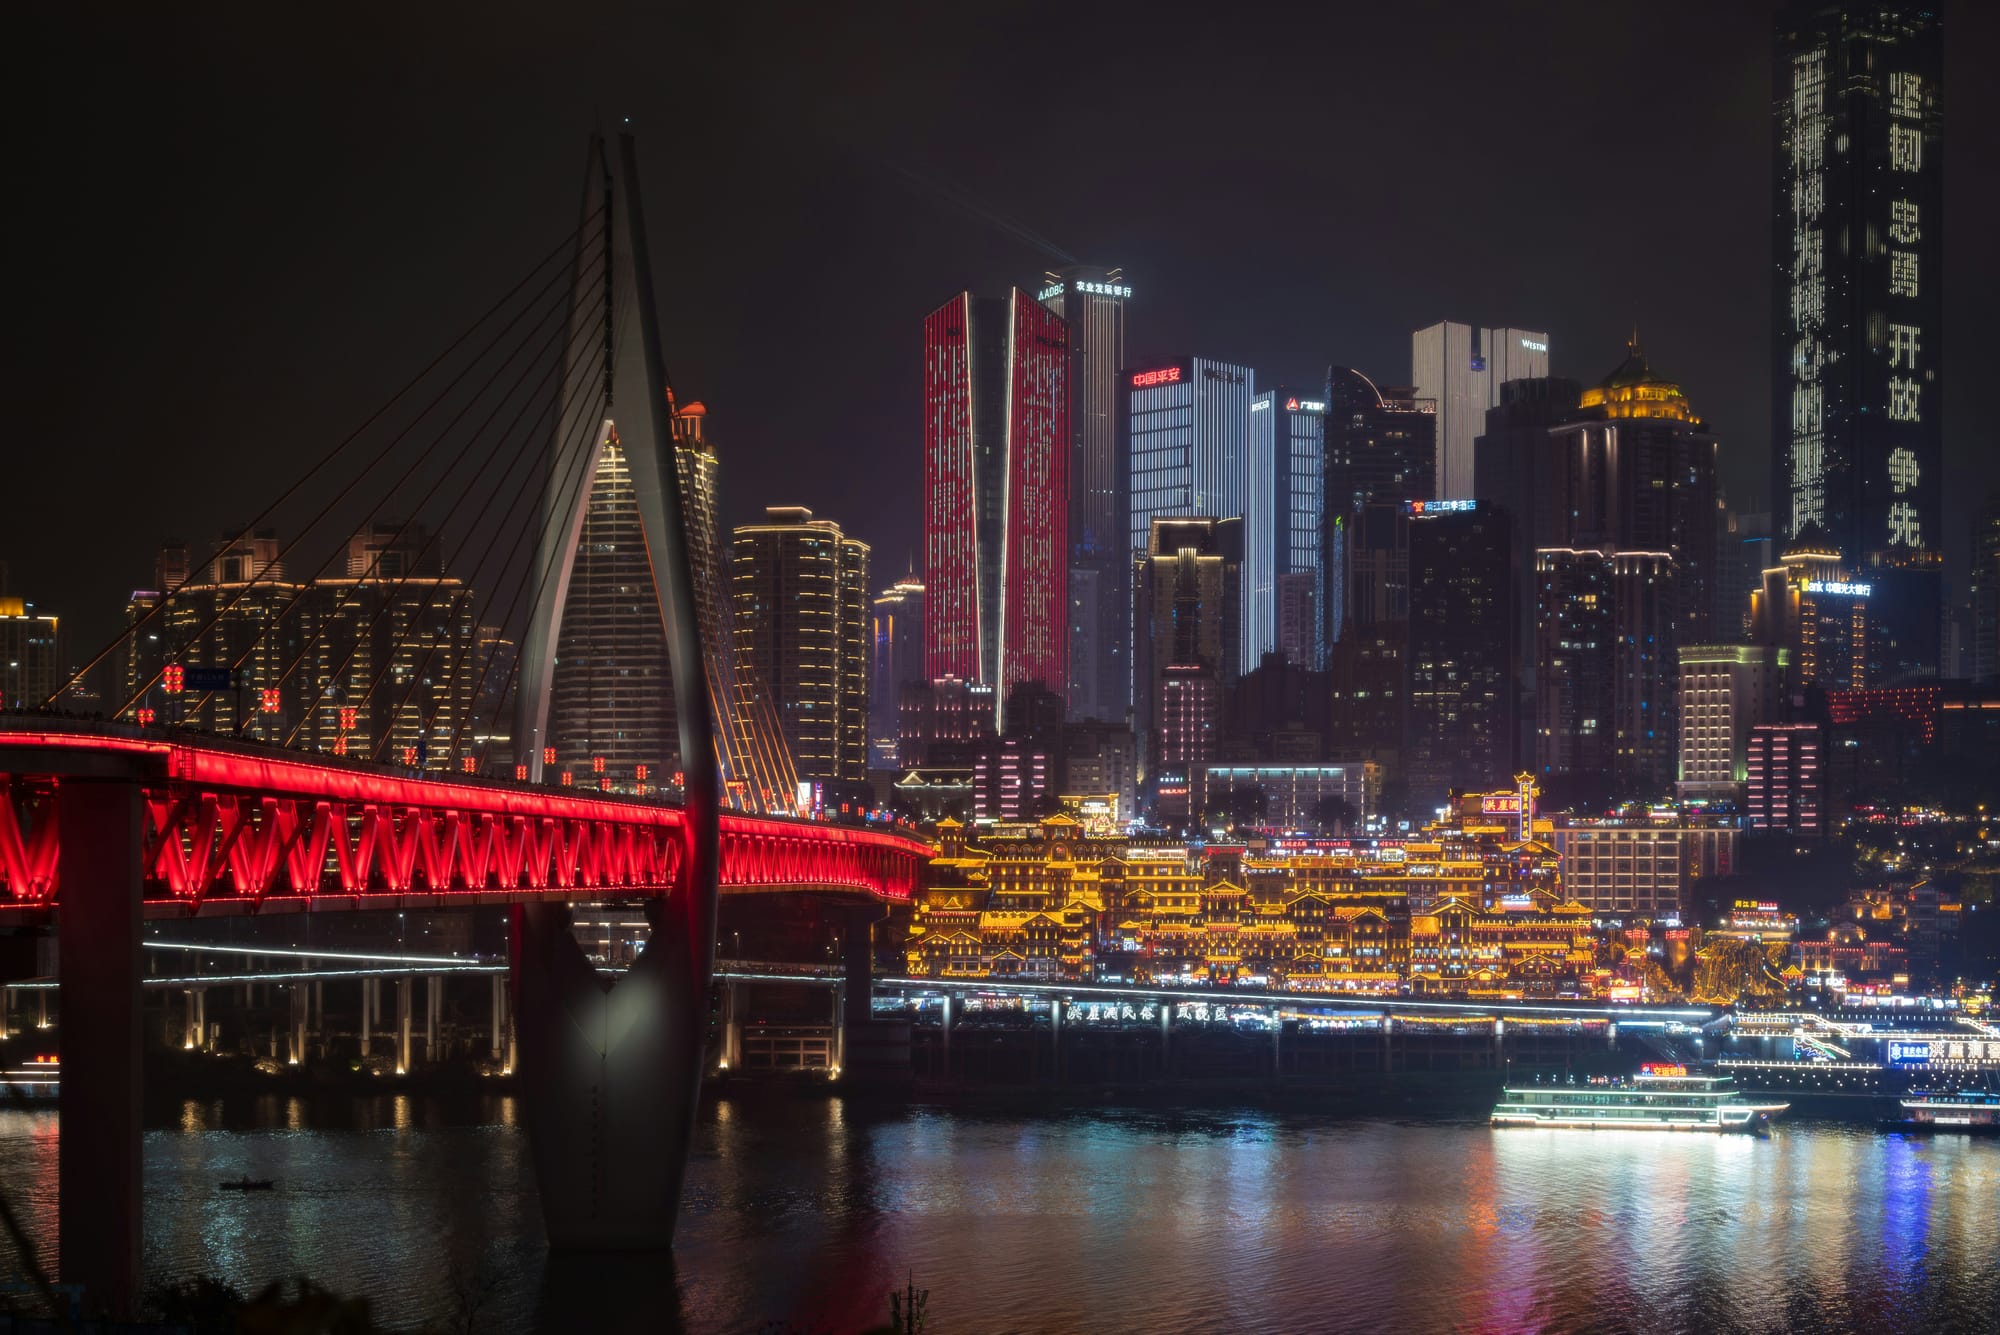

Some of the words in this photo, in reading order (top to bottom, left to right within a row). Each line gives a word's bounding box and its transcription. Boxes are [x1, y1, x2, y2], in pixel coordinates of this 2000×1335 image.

[1076, 281, 1132, 297] 农业发展银行
[1133, 367, 1181, 387] 中国平安
[1826, 582, 1871, 597] 中国光大银行
[1485, 799, 1520, 811] 洪崖洞
